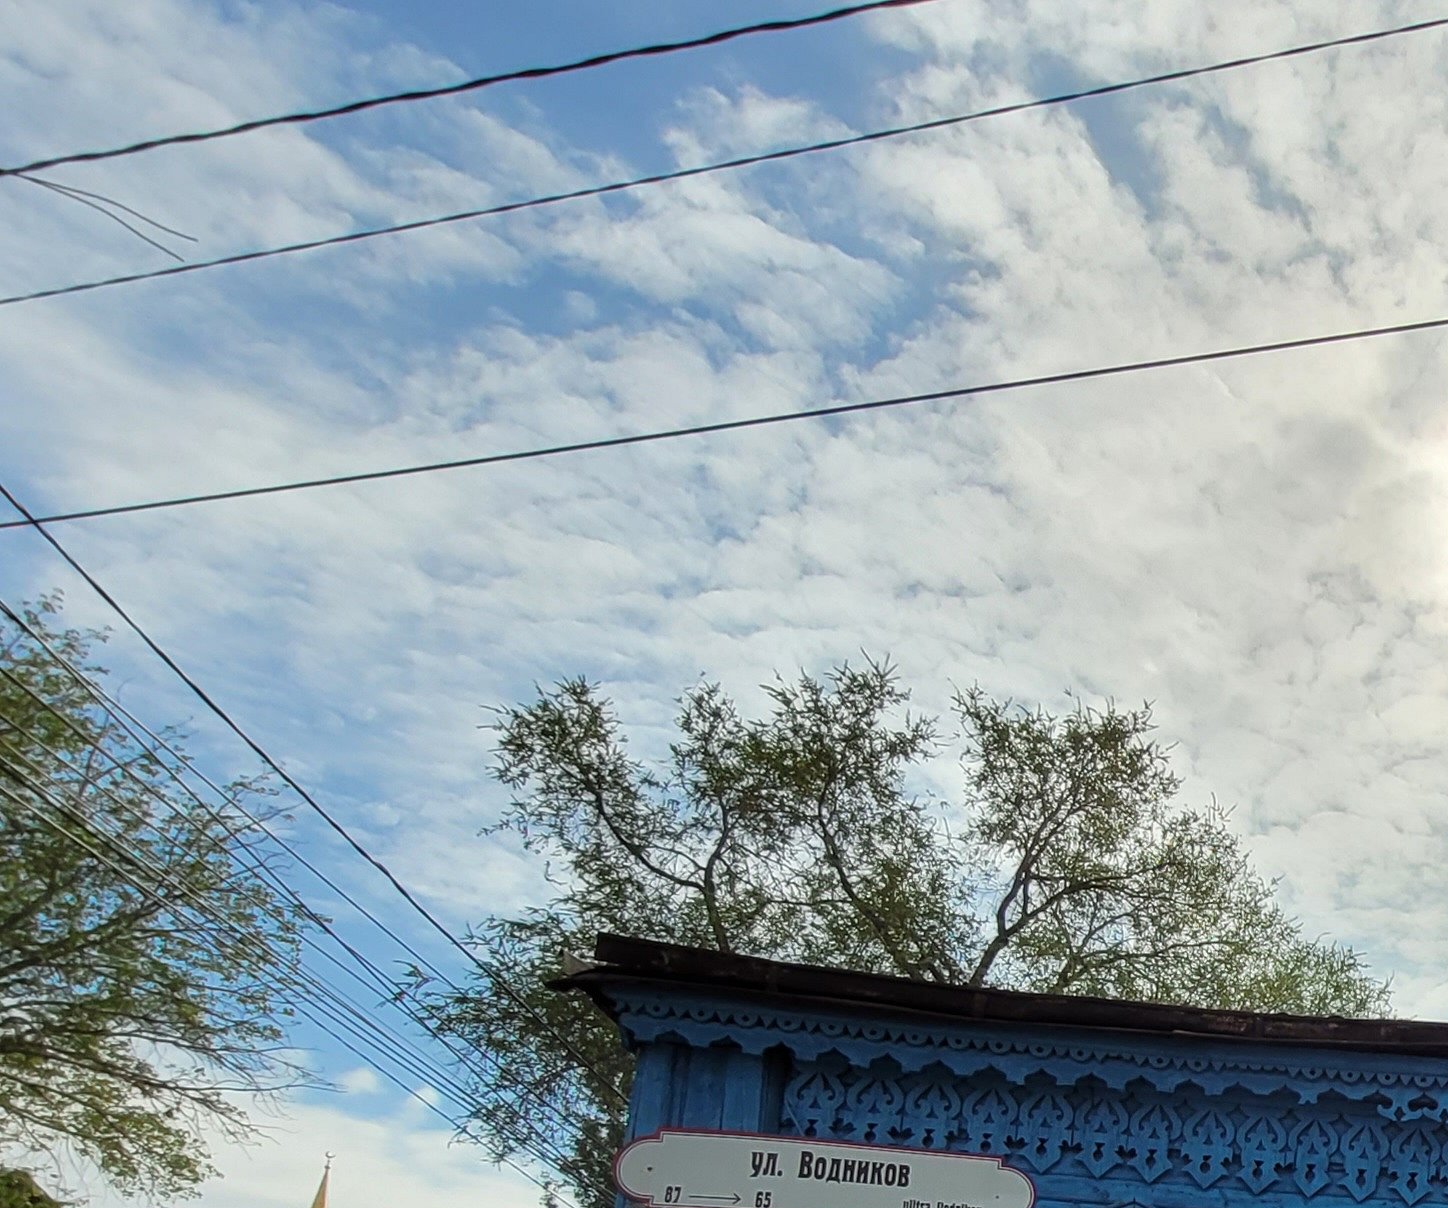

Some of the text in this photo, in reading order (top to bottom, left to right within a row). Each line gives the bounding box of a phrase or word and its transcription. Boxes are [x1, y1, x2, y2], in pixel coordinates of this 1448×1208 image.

[750, 1150, 911, 1188] ул. Водников
[664, 1185, 772, 1208] 87 65
